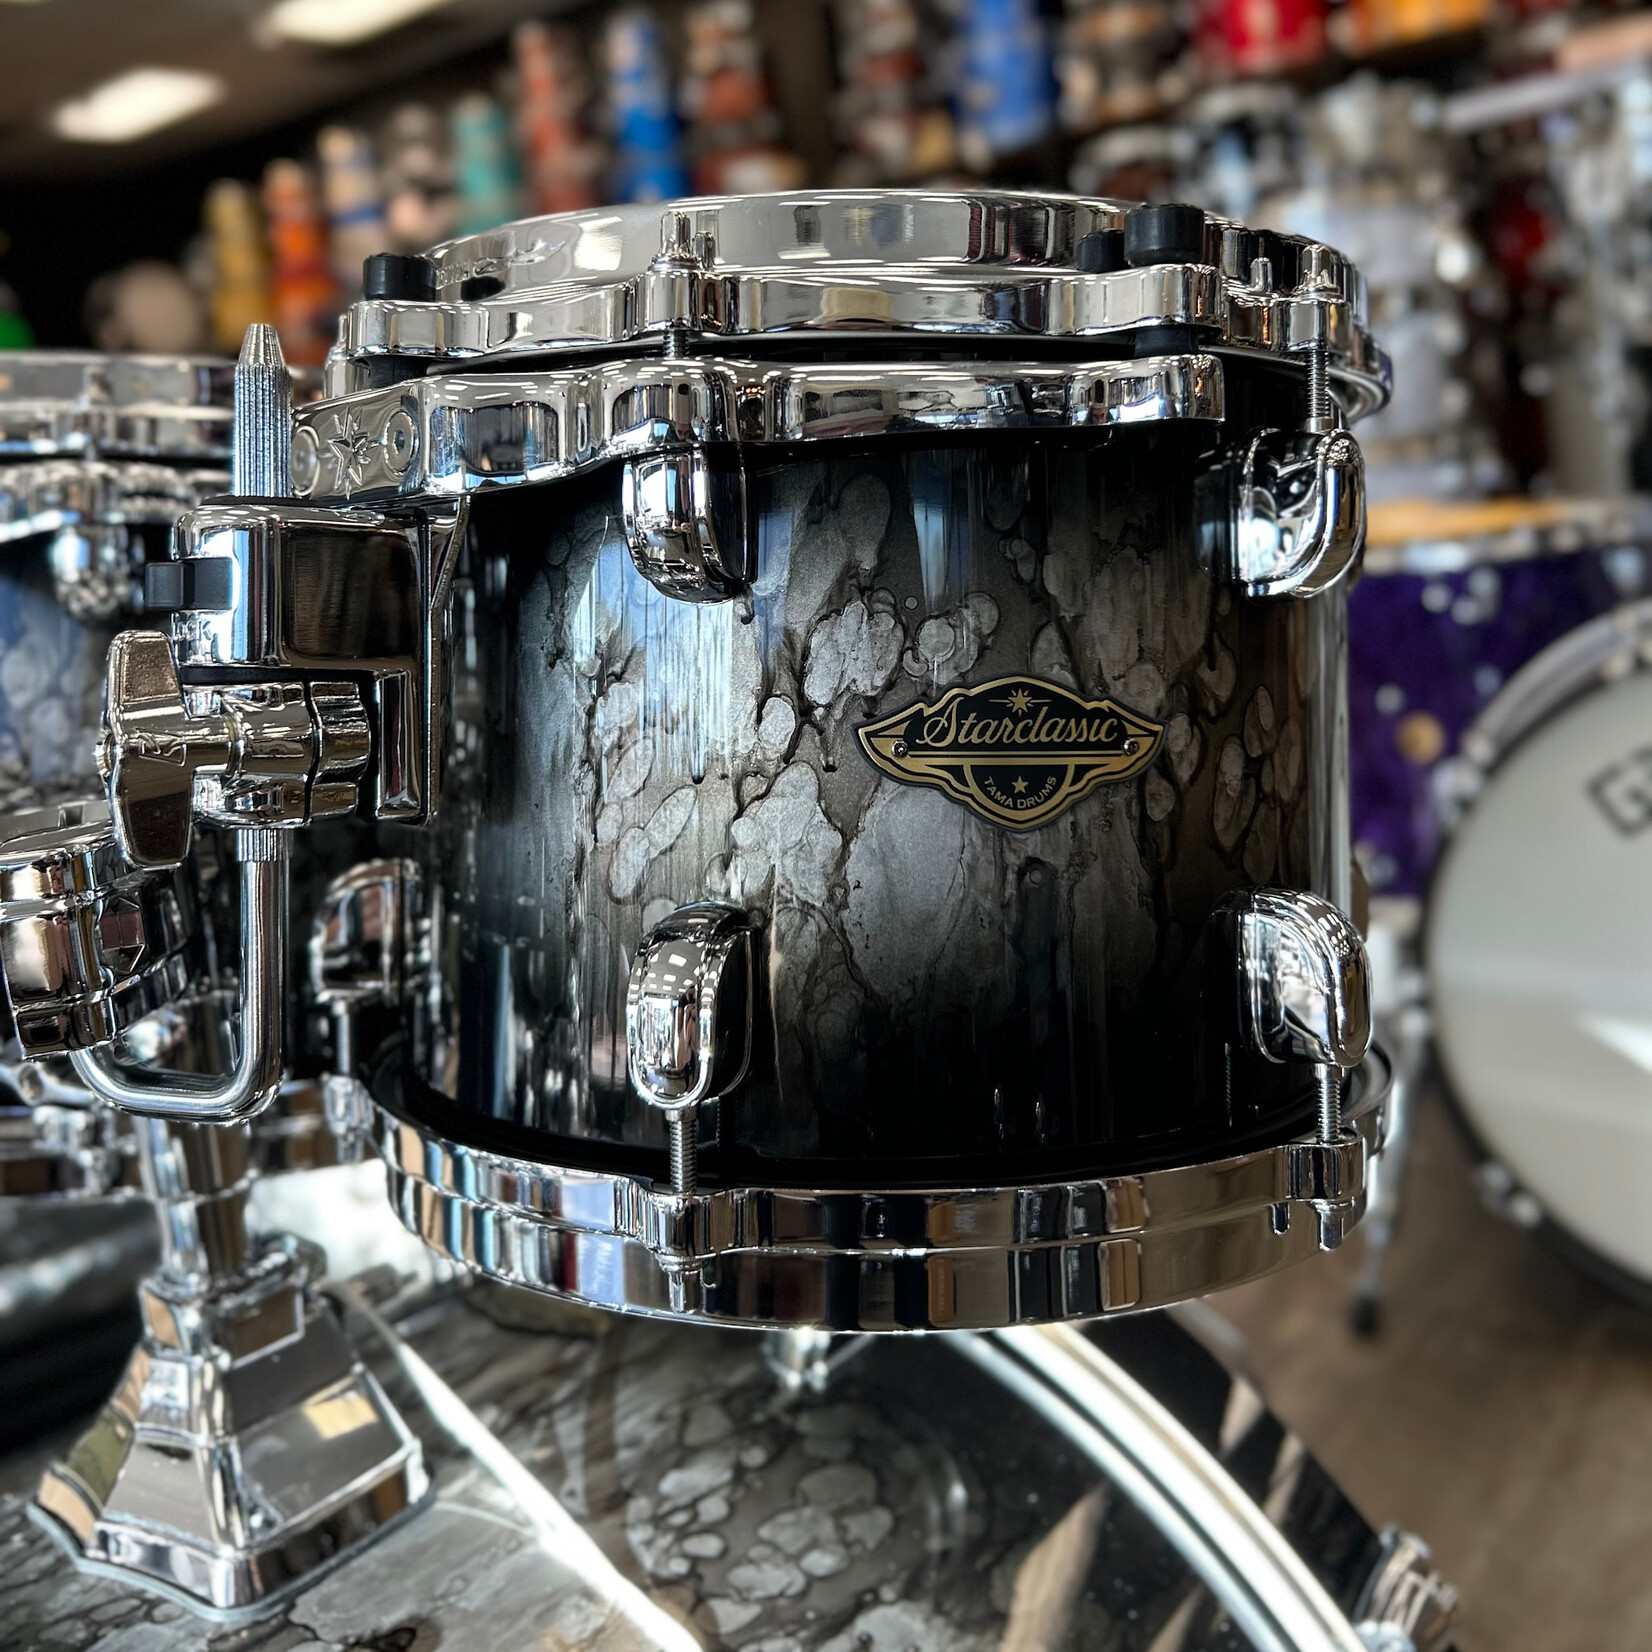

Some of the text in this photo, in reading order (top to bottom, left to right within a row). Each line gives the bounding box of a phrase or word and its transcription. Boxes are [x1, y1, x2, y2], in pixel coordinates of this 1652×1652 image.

[916, 697, 1118, 747] Starclassic
[984, 776, 1057, 809] TAMA DRUMS
